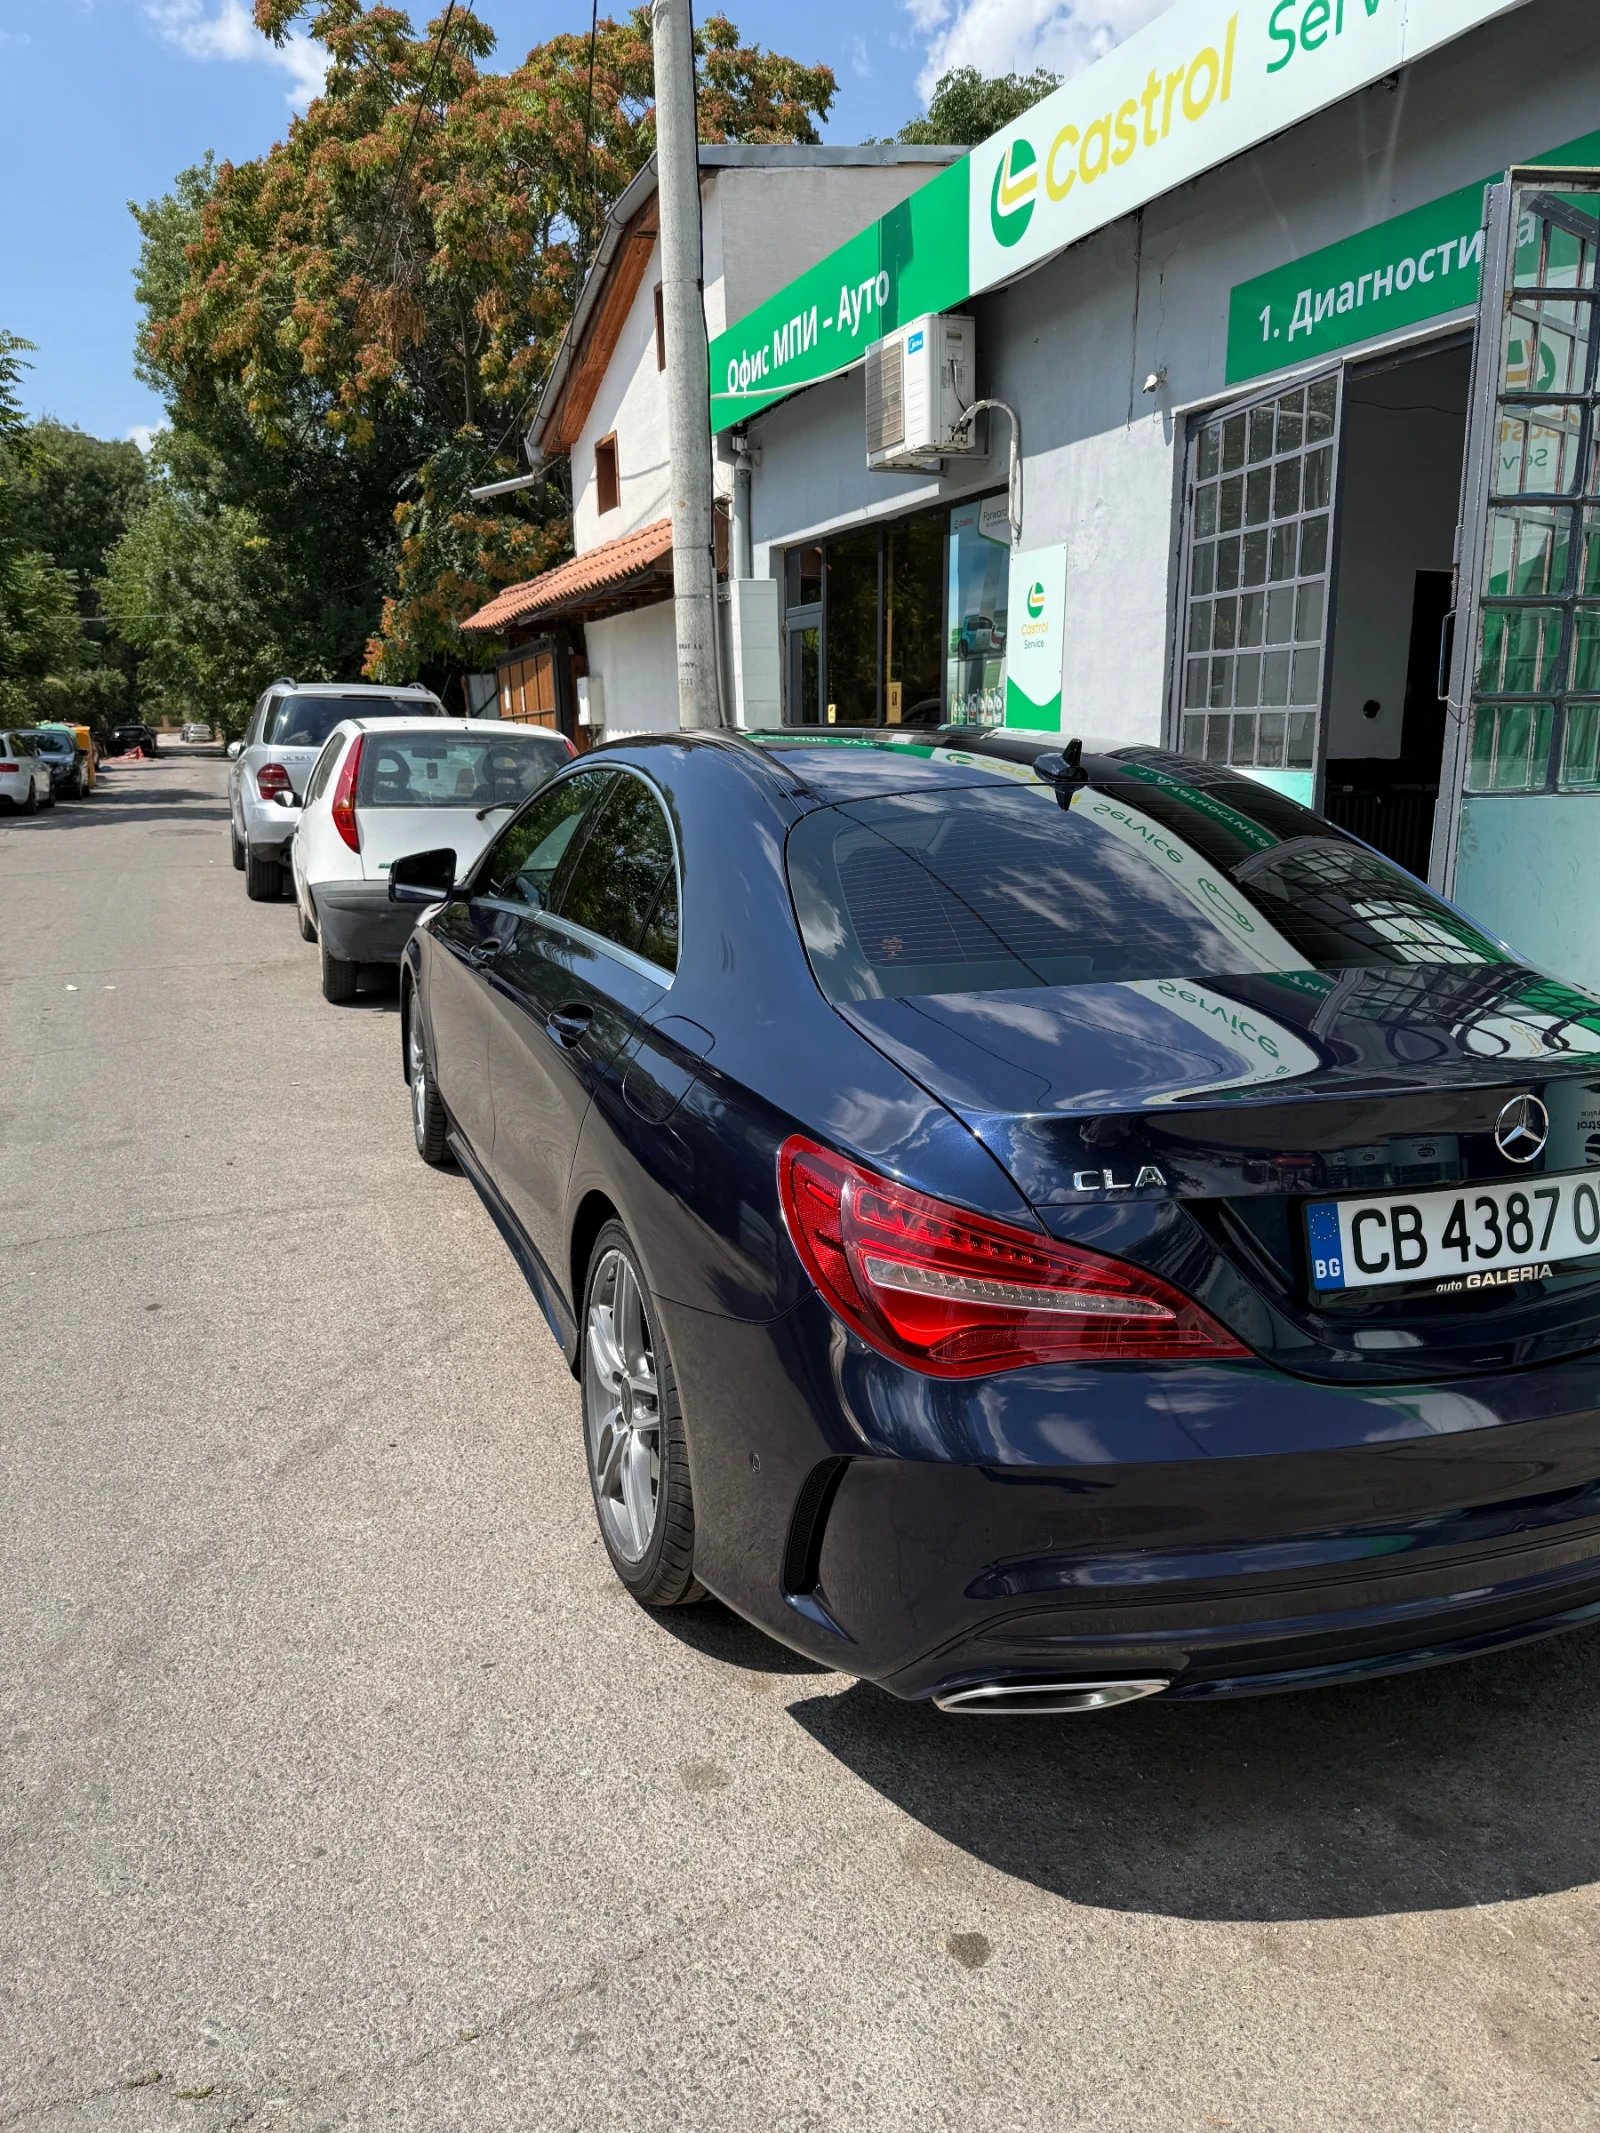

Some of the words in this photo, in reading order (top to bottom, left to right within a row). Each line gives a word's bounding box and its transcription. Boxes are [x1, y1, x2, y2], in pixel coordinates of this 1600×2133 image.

[1045, 11, 1239, 202] Castrol
[727, 350, 770, 398] Офис
[774, 304, 818, 369] МПИ
[837, 270, 890, 337] Ауто
[1259, 305, 1280, 343] 1.
[1021, 621, 1049, 636] Castrol
[1024, 638, 1045, 650] Service
[1073, 1166, 1168, 1192] CLA
[1351, 1205, 1428, 1274] CB
[1441, 1186, 1561, 1262] 4387
[1314, 1258, 1341, 1279] BG
[1436, 1279, 1463, 1293] auto
[1466, 1263, 1553, 1289] GALERIA
